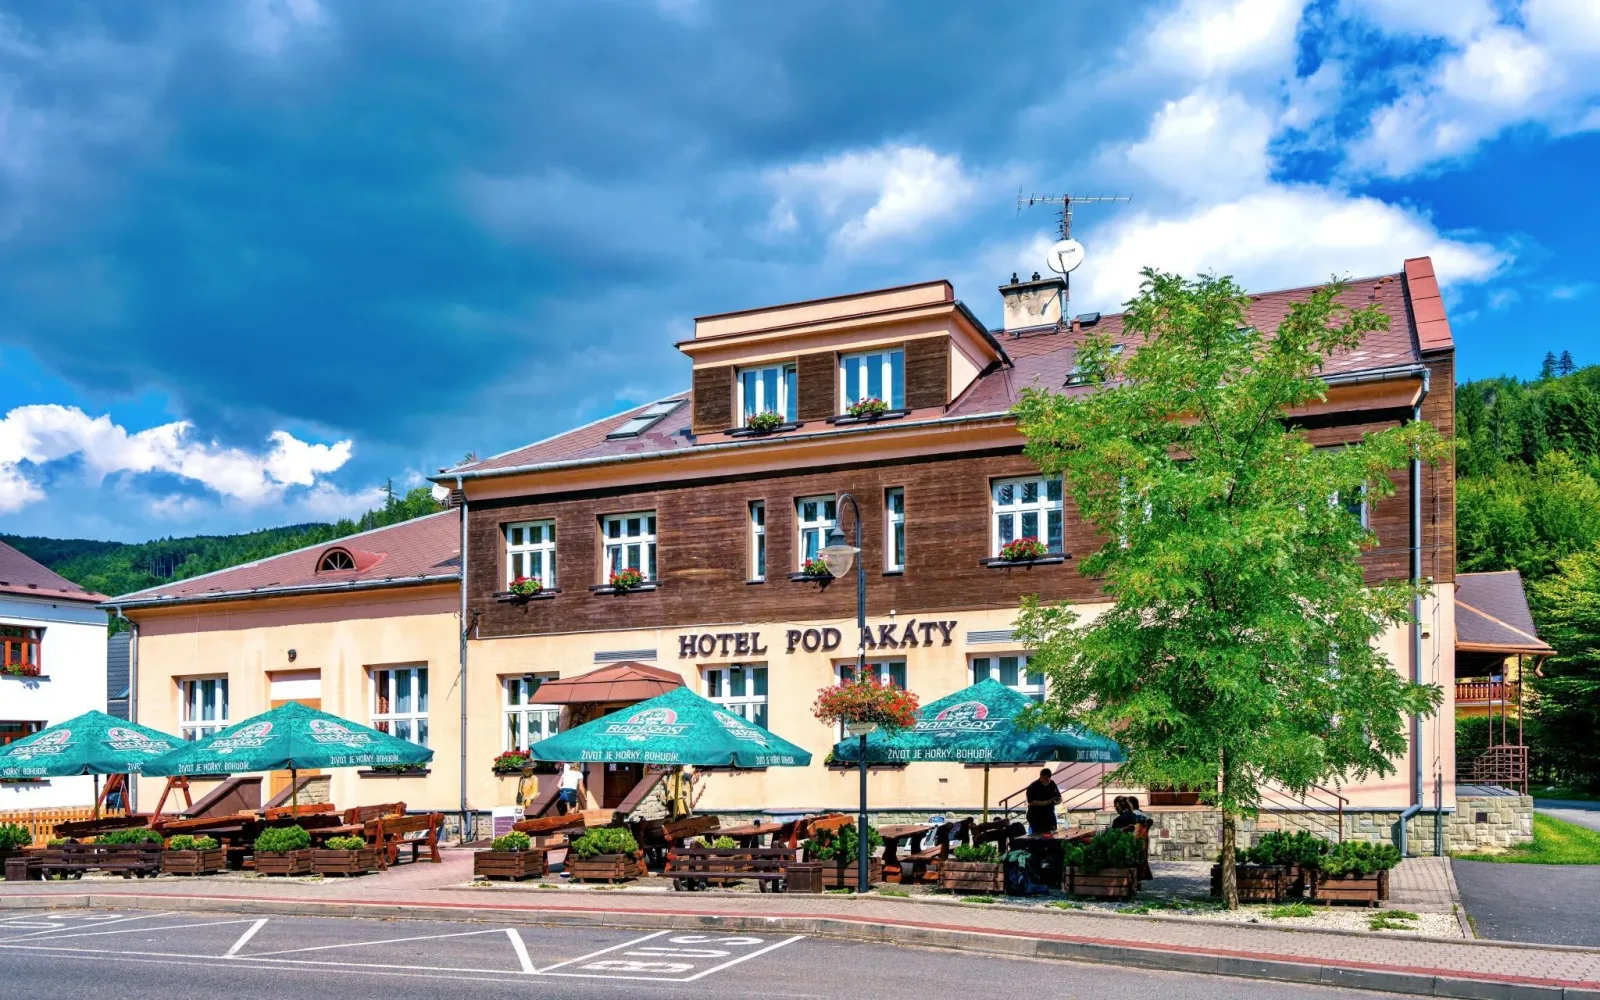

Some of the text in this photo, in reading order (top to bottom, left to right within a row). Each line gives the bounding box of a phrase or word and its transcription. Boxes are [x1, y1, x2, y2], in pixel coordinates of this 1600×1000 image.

[678, 618, 957, 659] HOTEL POD AKÁTY
[605, 723, 688, 735] RADEGAST
[914, 720, 1001, 731] RADEGAST
[581, 749, 680, 761] ŽIVOT JE HOŘKÝ. BOHUDÍK.
[888, 747, 995, 759] ŽIVOT JE HOŘKÝ. BOHUDÍK.
[349, 756, 355, 764] JE
[178, 763, 194, 773] ŽIVOT
[195, 763, 202, 772] JE
[577, 935, 764, 974] BUS
